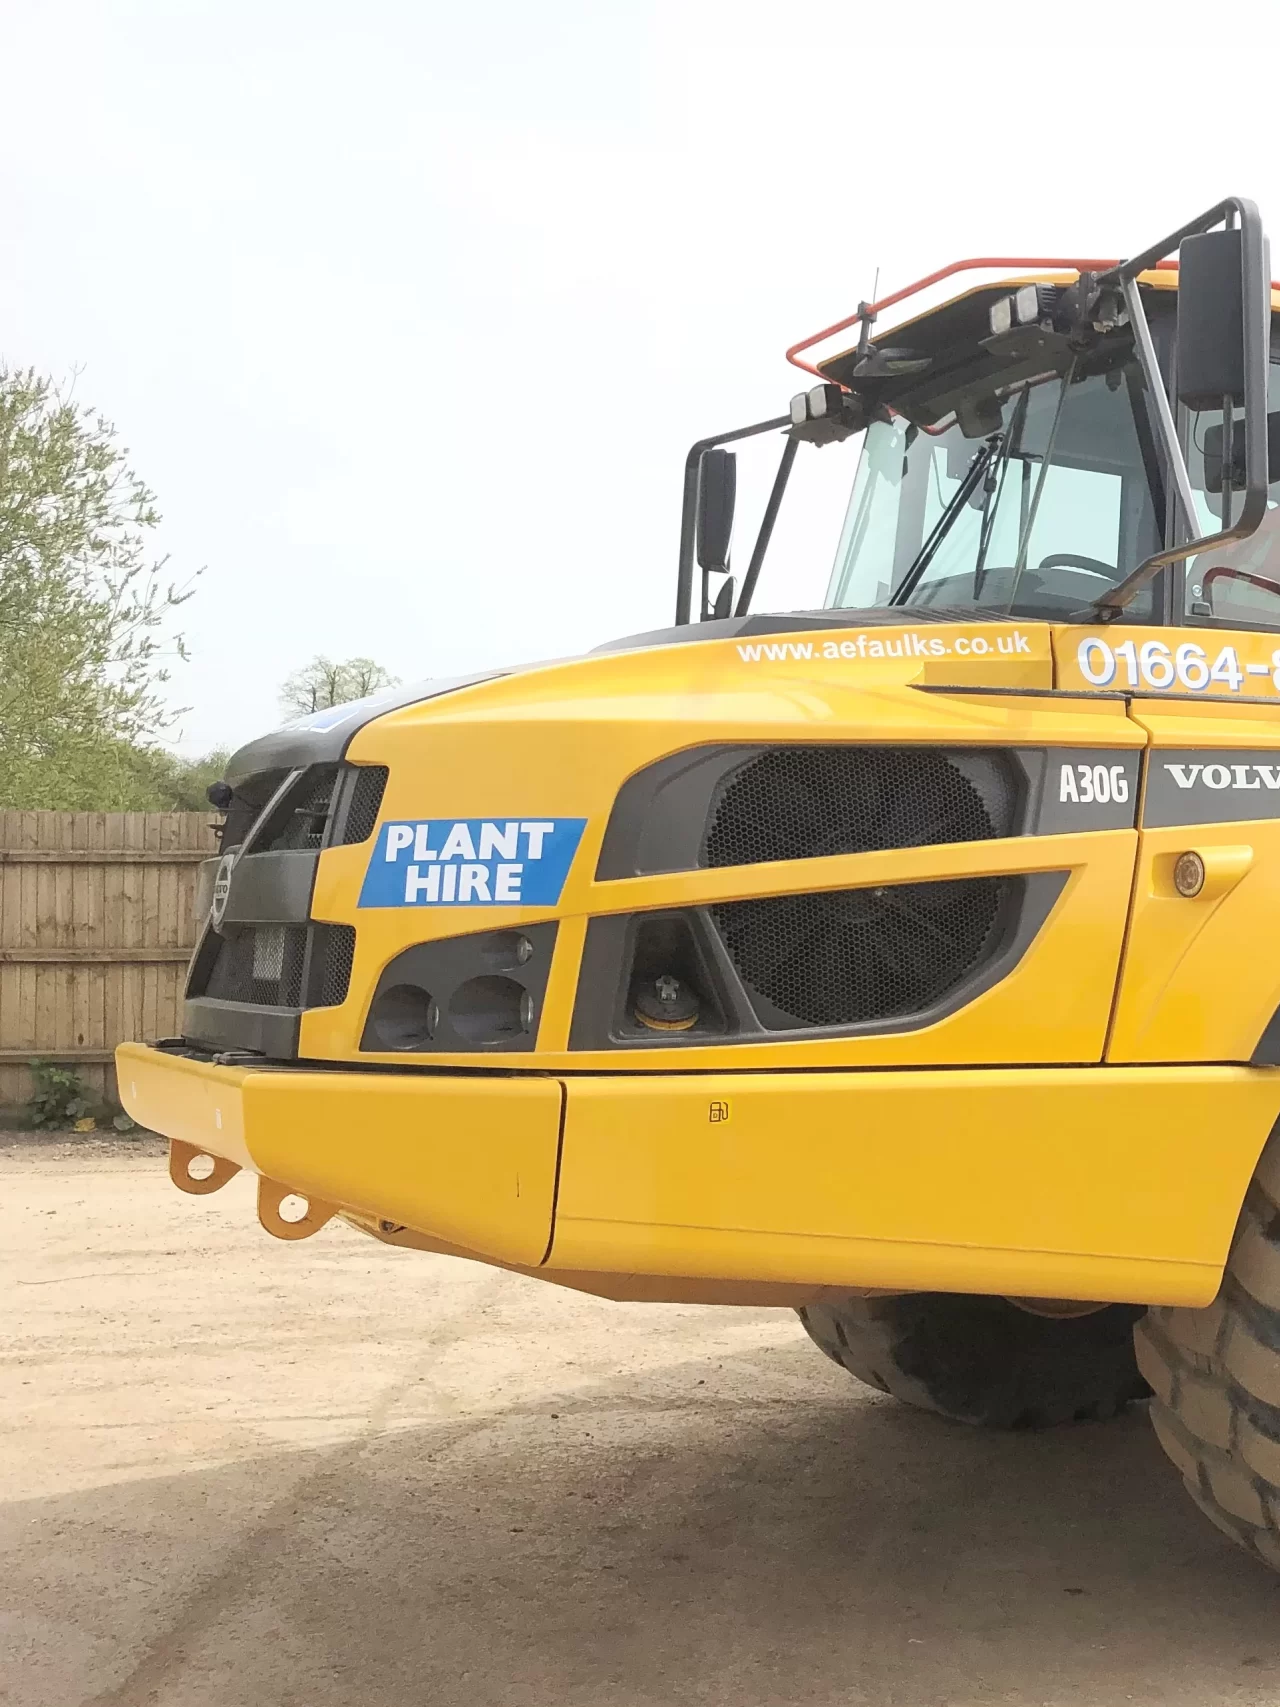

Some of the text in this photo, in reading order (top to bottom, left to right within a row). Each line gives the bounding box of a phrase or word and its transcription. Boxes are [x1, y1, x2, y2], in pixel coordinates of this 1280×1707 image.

[736, 631, 1031, 663] www.aefaulks.co.uk
[1059, 764, 1129, 803] A30G
[385, 822, 554, 863] PLANT
[404, 863, 523, 902] HIRE
